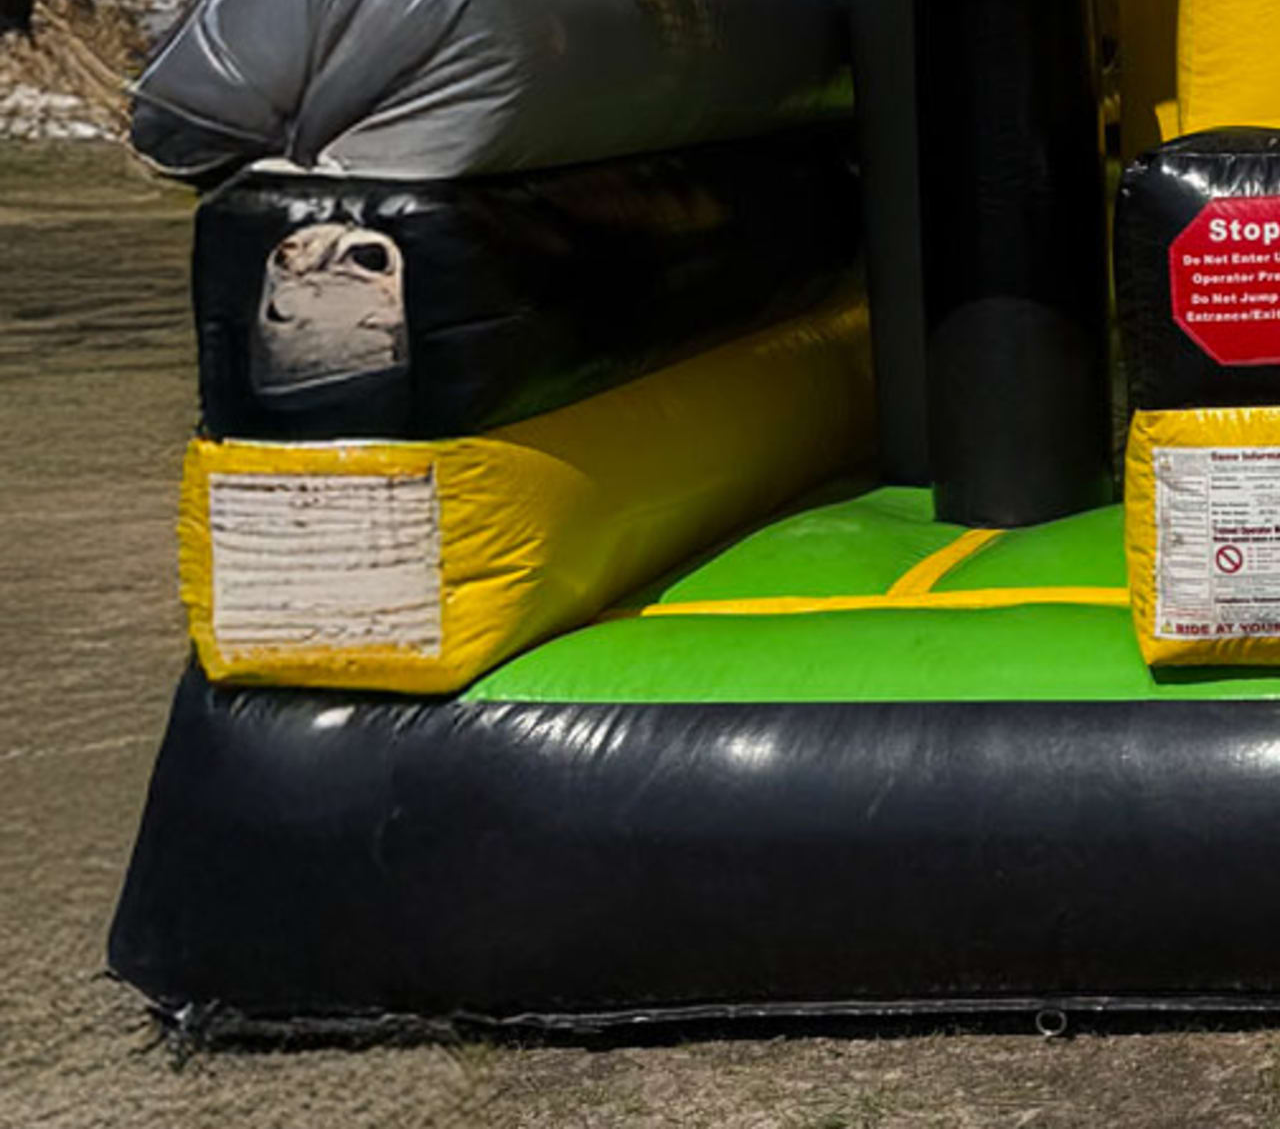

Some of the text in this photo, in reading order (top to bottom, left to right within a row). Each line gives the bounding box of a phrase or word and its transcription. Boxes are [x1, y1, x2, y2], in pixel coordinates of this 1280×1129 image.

[1182, 254, 1201, 266] Do
[1203, 254, 1228, 265] Not
[1231, 253, 1270, 265] Enter
[1192, 272, 1255, 286] Operator
[1191, 293, 1209, 305] Do
[1212, 292, 1237, 304] Not
[1240, 292, 1279, 304] Jump
[1175, 623, 1210, 634] RIDE
[1215, 623, 1234, 634] AT
